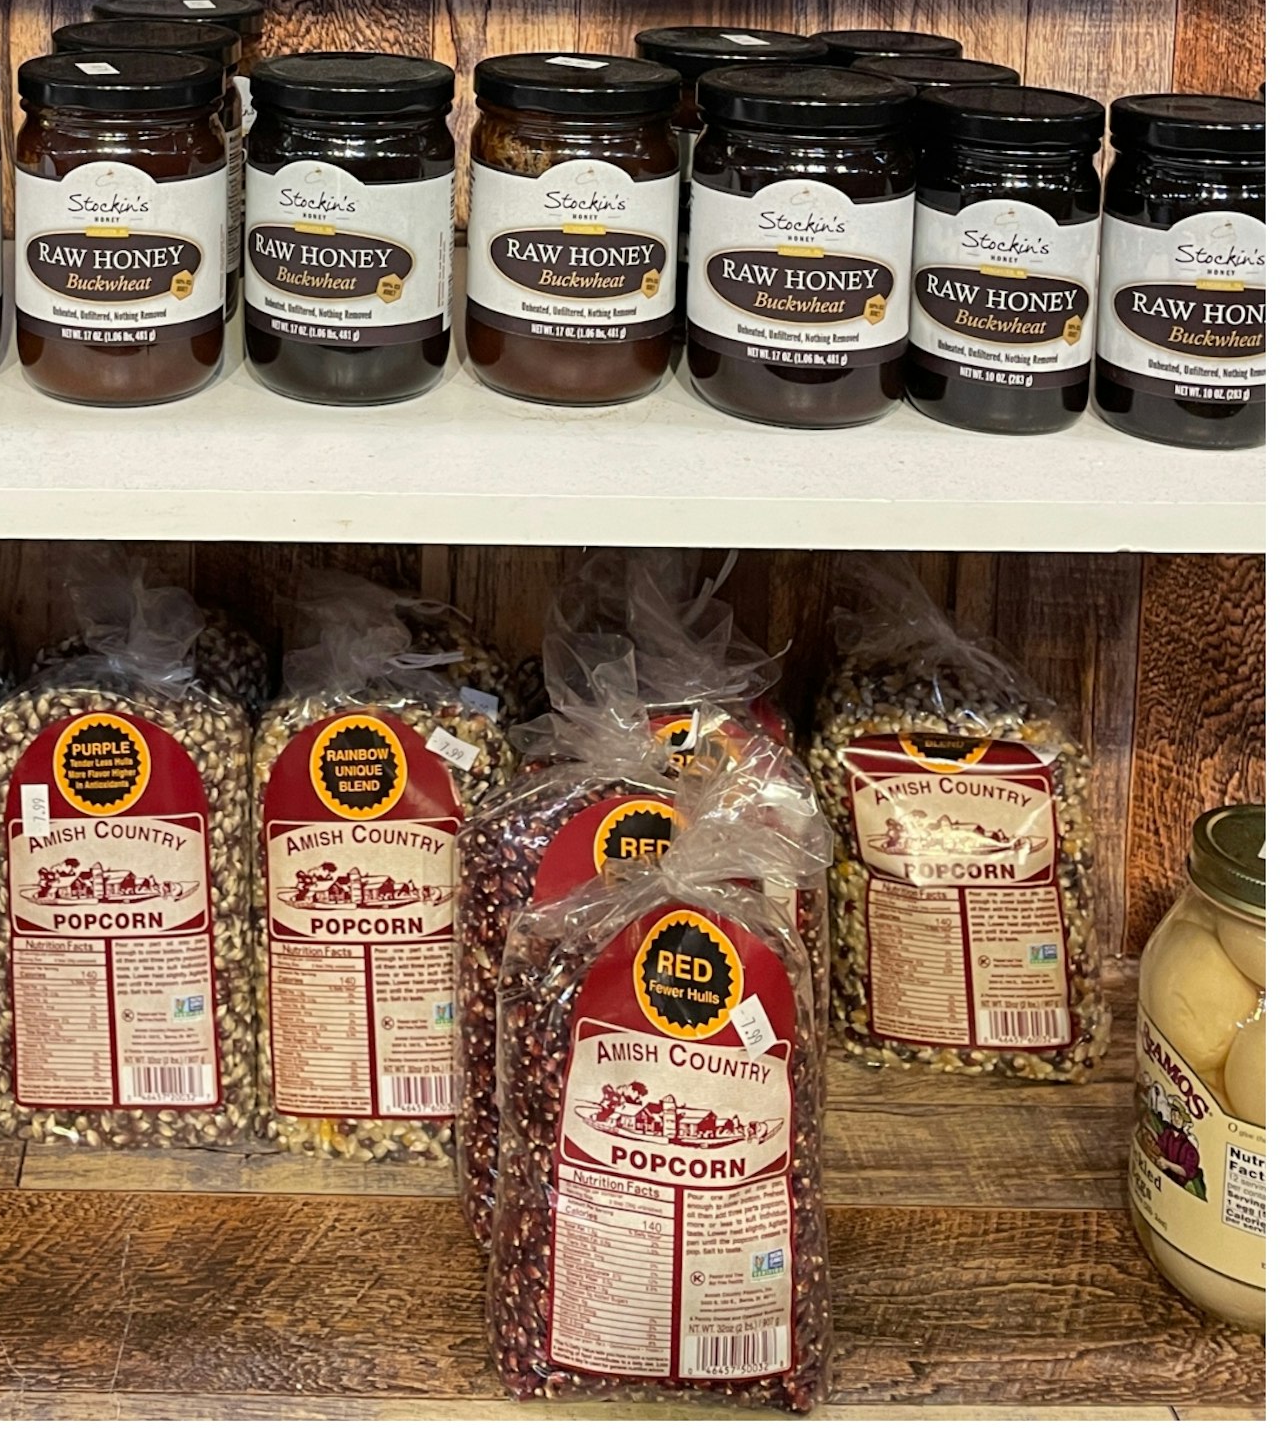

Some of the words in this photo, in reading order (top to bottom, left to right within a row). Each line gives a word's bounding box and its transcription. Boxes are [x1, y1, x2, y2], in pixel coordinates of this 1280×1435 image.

[68, 193, 150, 215] Stockin's
[279, 188, 357, 213] Stockin's
[544, 191, 626, 212] Stockin's
[759, 212, 846, 234] Stockin's
[255, 233, 296, 262] RAW
[300, 245, 393, 269] HONEY
[506, 238, 563, 264] RAW
[569, 244, 655, 267] HONEY
[961, 230, 1050, 256] Stockin's
[39, 242, 88, 268] RAW
[93, 244, 184, 269] HONEY
[1175, 244, 1265, 267] Stockin's
[66, 273, 152, 291] Buckwheat
[277, 266, 358, 291] Buckwheat
[539, 269, 626, 288] Buckwheat
[722, 258, 778, 287] RAW
[784, 268, 879, 291] HONEY
[754, 291, 846, 314] Buckwheat
[926, 273, 983, 304] RAW
[986, 289, 1078, 313] HONEY
[1132, 292, 1196, 321] RAW
[1203, 303, 1266, 326] HON
[954, 309, 1047, 336] Buckwheat
[1168, 326, 1264, 348] Buckwheat
[71, 742, 130, 756] PURPLE
[326, 748, 389, 762] RAINBOW
[334, 763, 383, 777] UNIQUE
[338, 779, 380, 793] BLEND
[874, 779, 931, 806] AMISH
[939, 778, 1032, 808] COUNTRY
[28, 826, 86, 854] AMISH
[95, 820, 187, 852] COUNTRY
[286, 830, 343, 856] AMISH
[352, 825, 445, 855] COUNTRY
[905, 863, 1015, 880] POPCORN
[53, 913, 164, 931] POPCORN
[310, 918, 424, 936] POPCORN
[26, 939, 65, 951] Nutrition
[67, 942, 94, 952] Facts
[282, 944, 322, 957] Nutrition
[325, 946, 352, 957] Facts
[657, 950, 713, 983] RED
[649, 978, 685, 999] Fewer
[687, 987, 720, 1005] Hulls
[596, 1040, 658, 1065] AMISH
[669, 1044, 772, 1086] COUNTRY
[611, 1146, 746, 1180] POPCORN
[573, 1170, 625, 1192] Nutrition
[626, 1181, 660, 1198] Facts
[642, 1219, 663, 1233] 140
